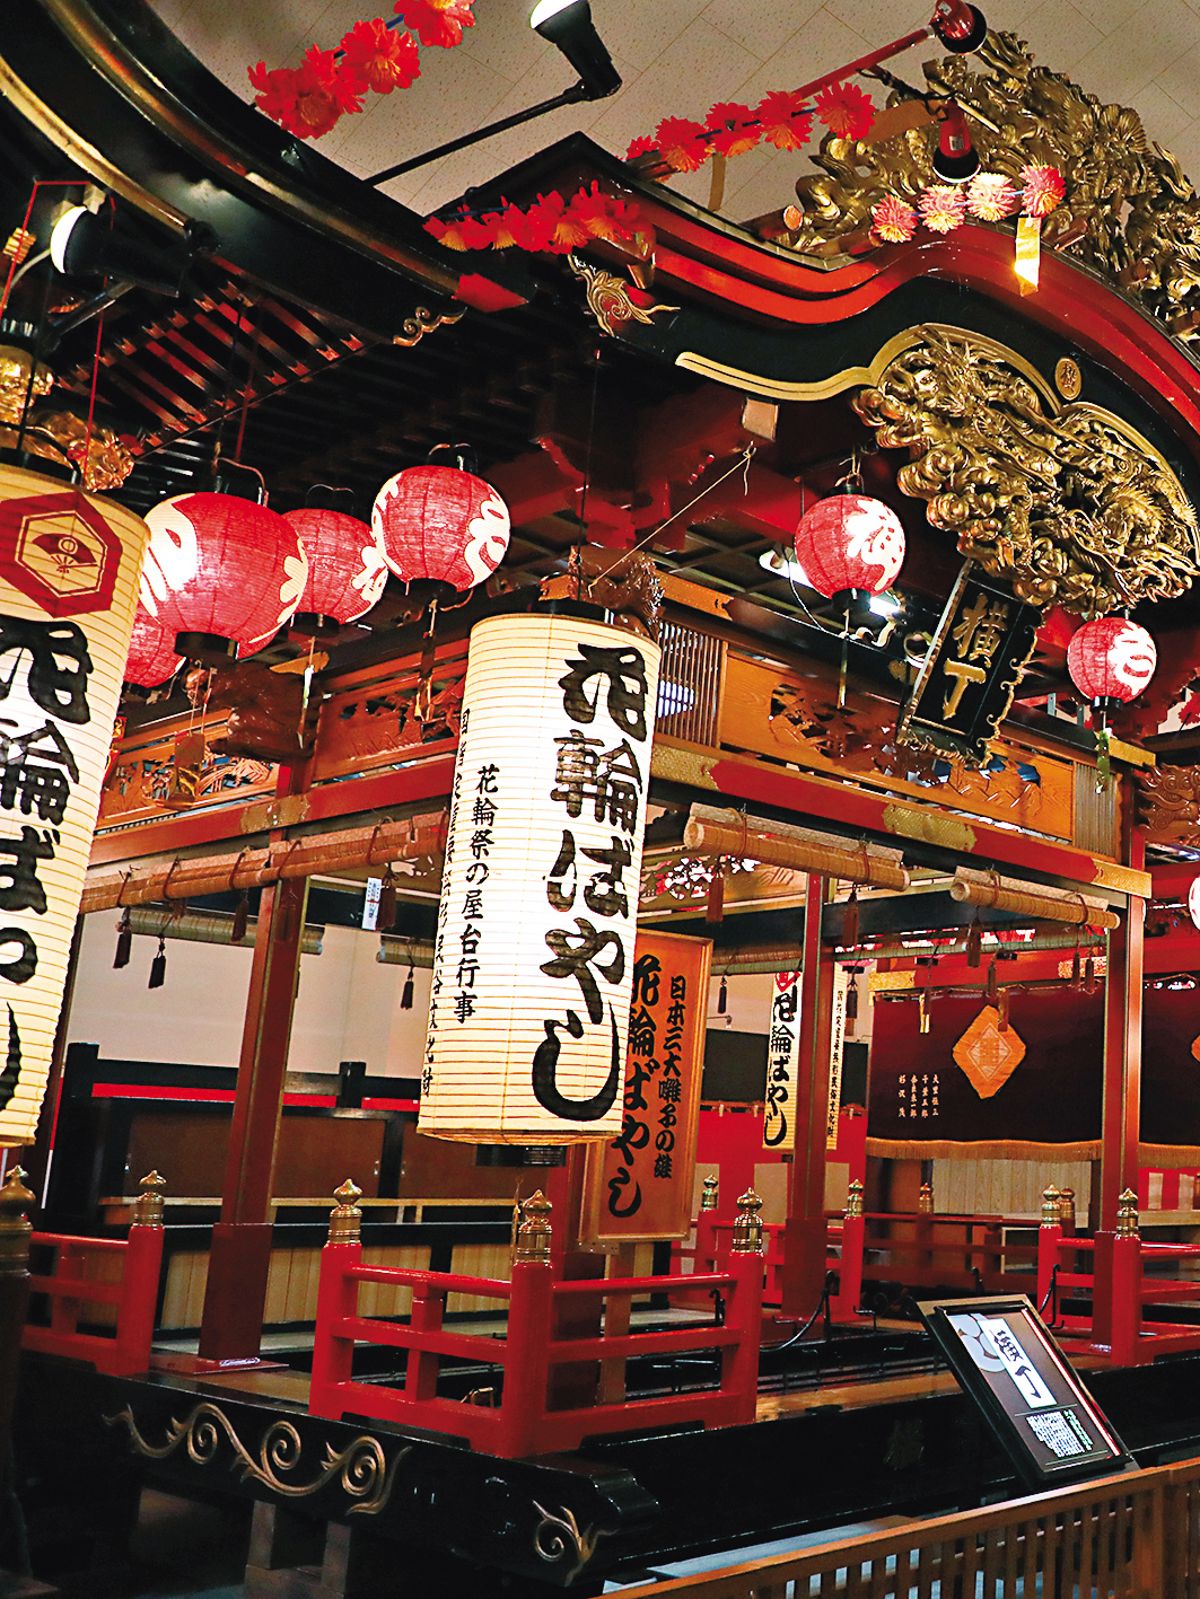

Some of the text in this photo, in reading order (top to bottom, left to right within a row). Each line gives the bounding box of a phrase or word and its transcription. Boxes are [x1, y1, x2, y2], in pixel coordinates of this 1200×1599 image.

[943, 592, 1008, 720] 横丁
[453, 764, 500, 1024] 花輪祭の屋台行事
[532, 643, 648, 1121] 花輪ばやし
[653, 976, 686, 1179] 日本三大囃子の雄
